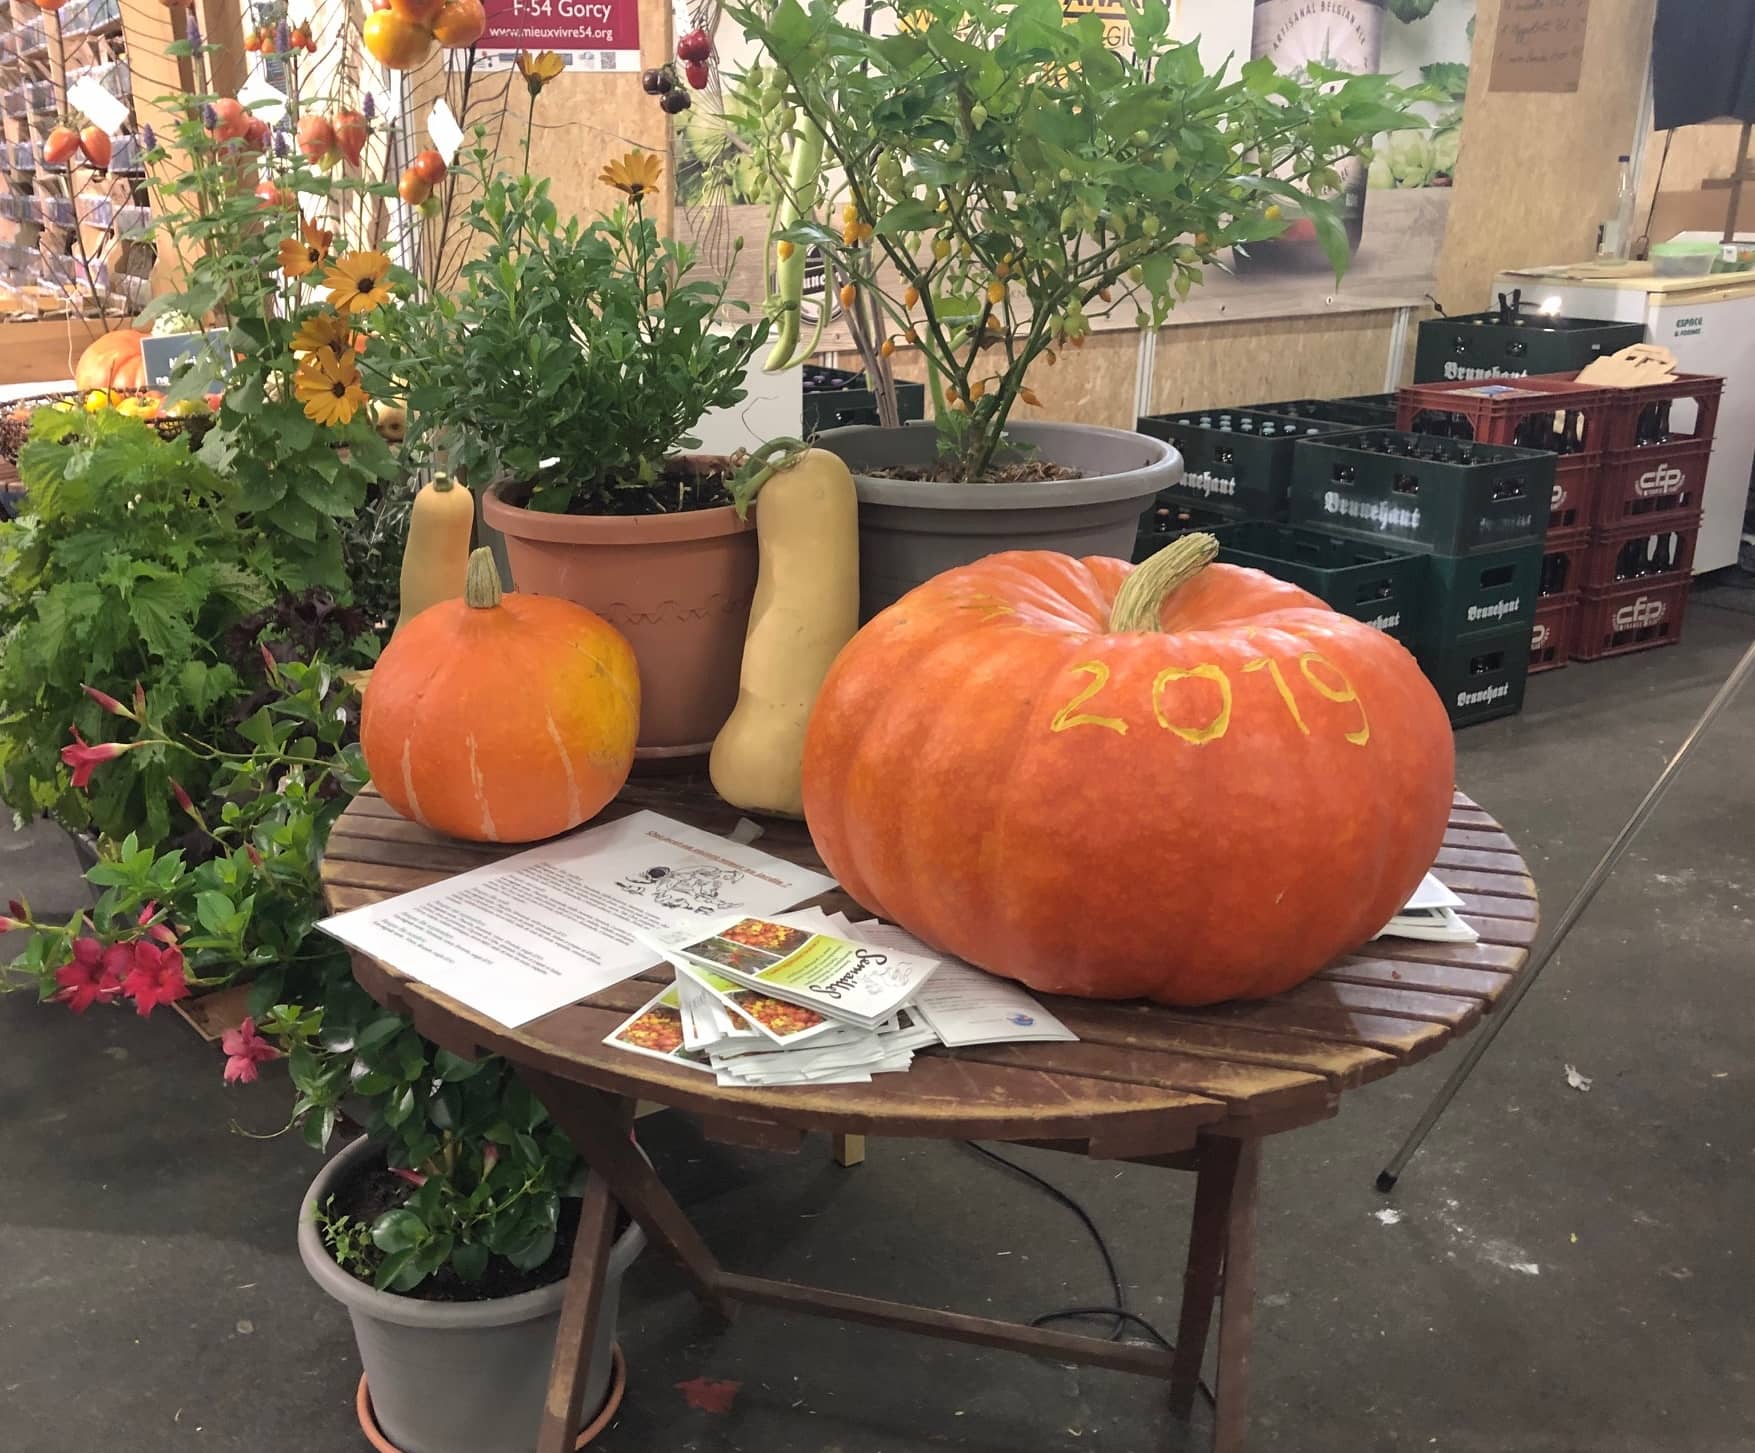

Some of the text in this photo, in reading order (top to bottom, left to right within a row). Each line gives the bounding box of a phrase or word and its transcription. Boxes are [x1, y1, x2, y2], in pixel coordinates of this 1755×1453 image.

[558, 0, 611, 23] Gorcy
[489, 26, 613, 41] www.mieuxvivre54.org
[1272, 3, 1316, 50] ARTISANAL
[1320, 0, 1356, 24] BELGIAN
[1324, 491, 1420, 530] Brunehaut
[1467, 598, 1520, 622] Brunehaut
[1050, 651, 1371, 746] 2019
[1457, 682, 1509, 706] Brunehaut
